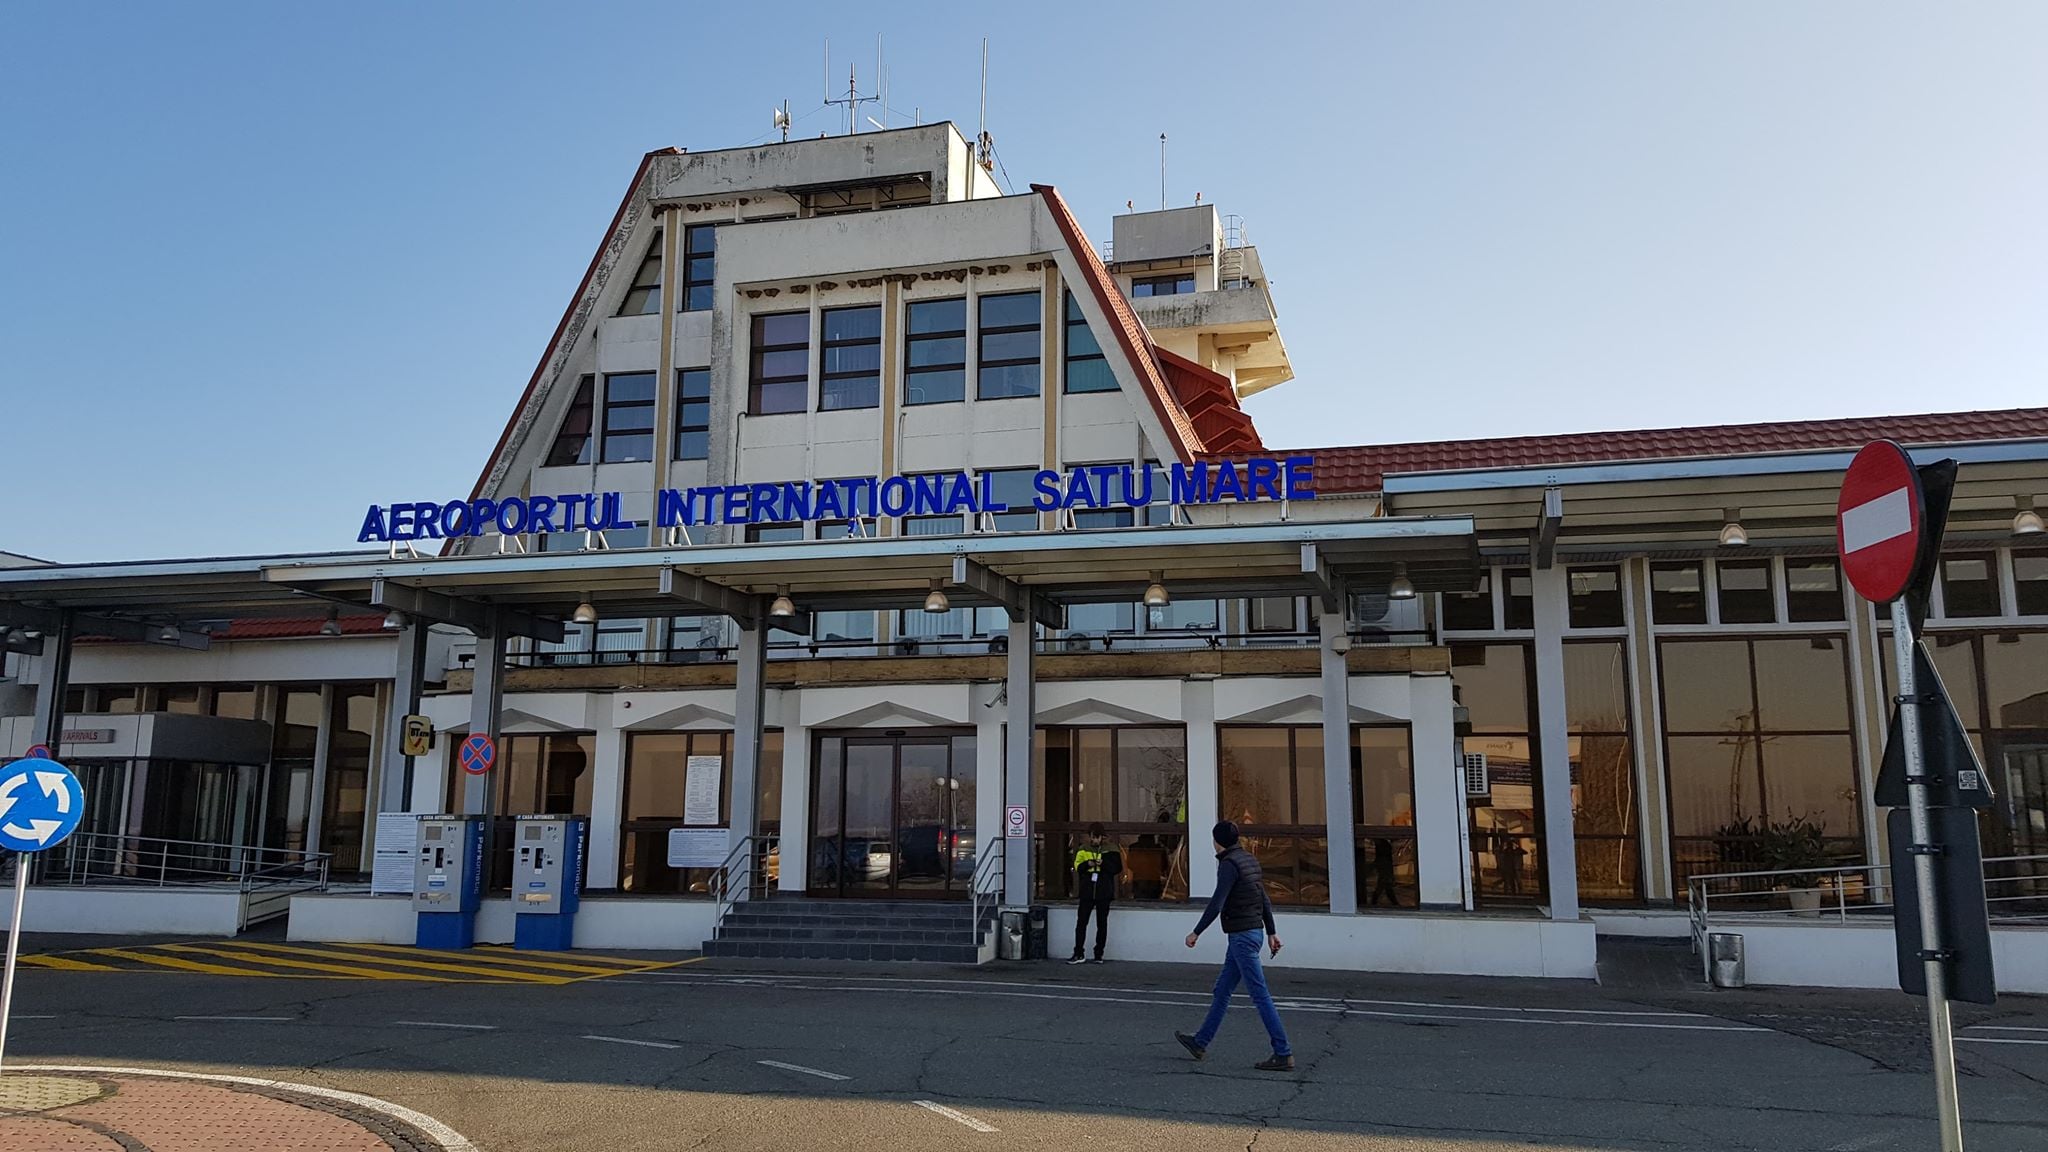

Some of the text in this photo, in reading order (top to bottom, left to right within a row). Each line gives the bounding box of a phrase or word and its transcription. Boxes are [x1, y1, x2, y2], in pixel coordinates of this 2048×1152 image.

[357, 491, 637, 542] AEROPORTUL
[1033, 463, 1154, 512] SATU
[1171, 455, 1316, 505] MARE
[474, 836, 484, 895] Parkomatic
